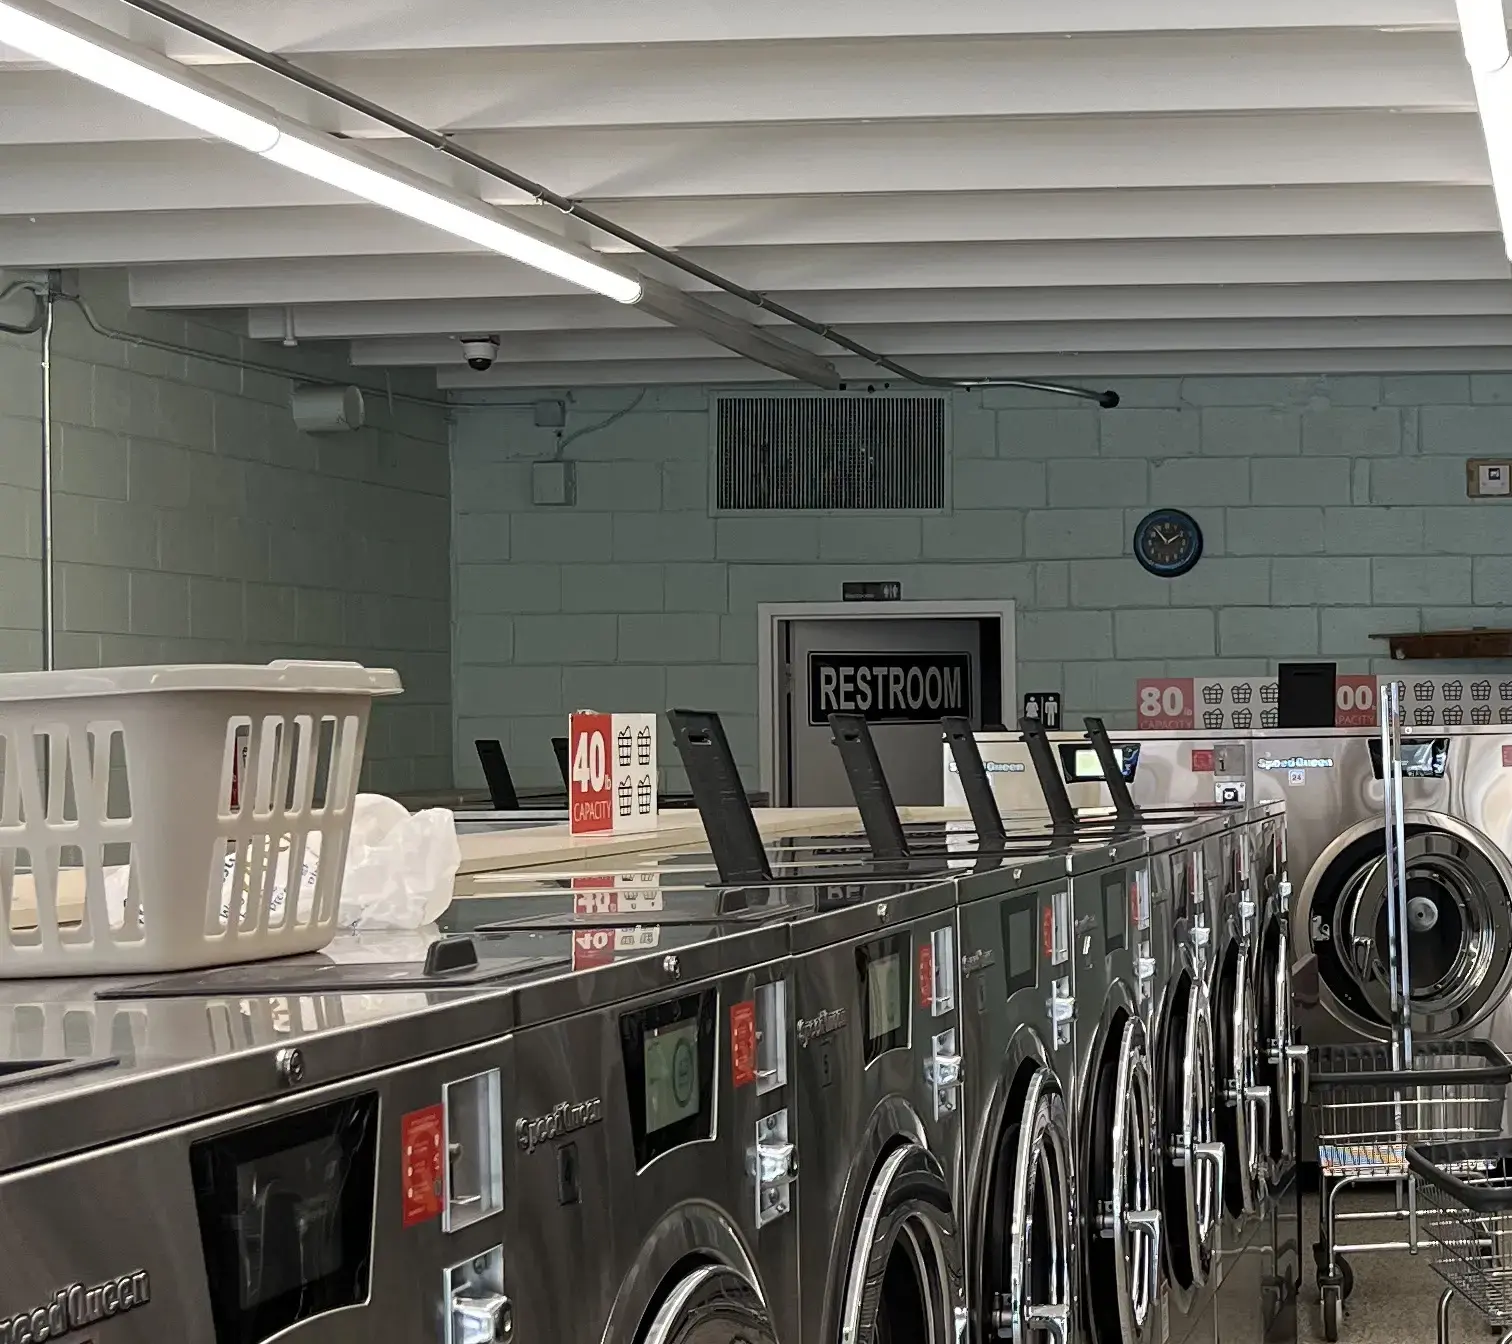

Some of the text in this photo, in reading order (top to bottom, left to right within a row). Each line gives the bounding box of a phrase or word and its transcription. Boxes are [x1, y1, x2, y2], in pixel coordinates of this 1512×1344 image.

[820, 666, 962, 711] RESTROOM
[1140, 686, 1184, 717] 80
[1336, 685, 1373, 711] 00
[1335, 715, 1375, 726] PACITY
[572, 730, 606, 793] 40
[573, 800, 612, 823] CAPACITY
